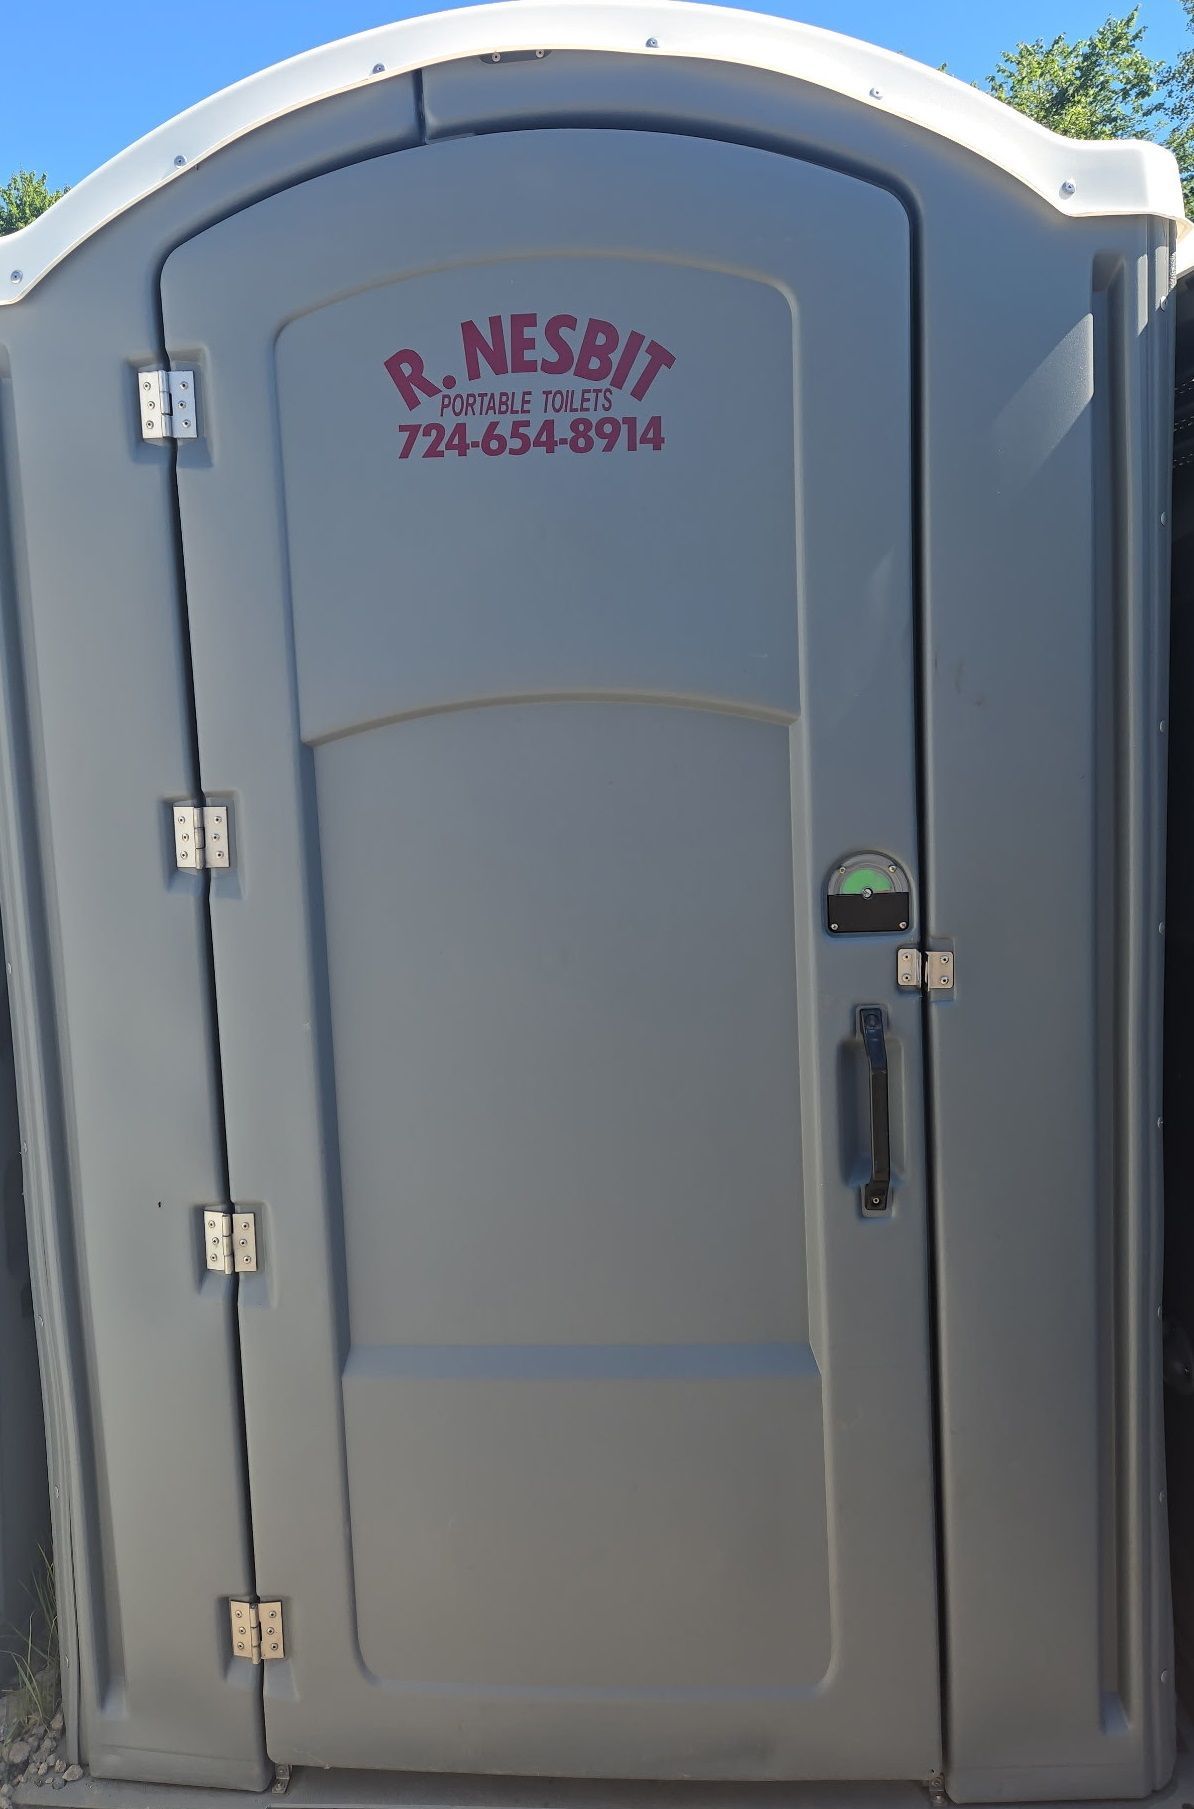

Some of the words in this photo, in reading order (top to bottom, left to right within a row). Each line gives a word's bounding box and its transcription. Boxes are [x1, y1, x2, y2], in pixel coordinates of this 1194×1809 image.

[384, 348, 457, 412] R.
[460, 312, 677, 402] NESBIT
[440, 390, 532, 417] PORTABLE
[542, 387, 613, 414] TOILETS
[398, 415, 665, 460] 724-654-8914
